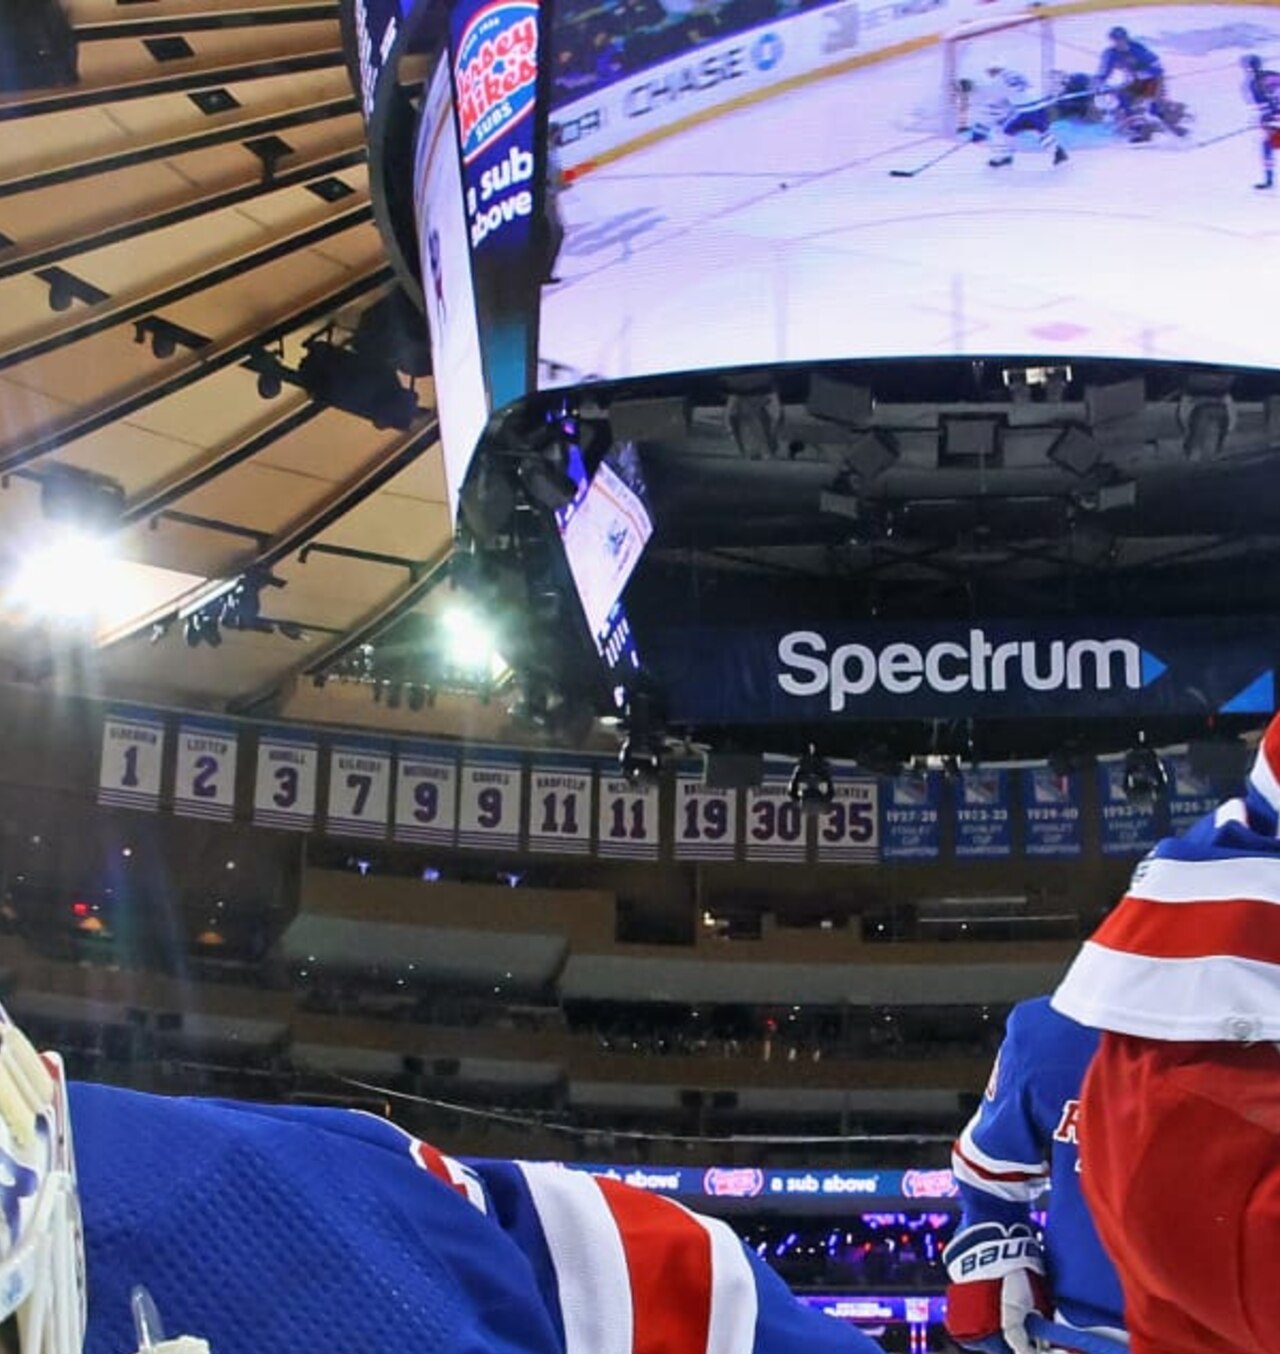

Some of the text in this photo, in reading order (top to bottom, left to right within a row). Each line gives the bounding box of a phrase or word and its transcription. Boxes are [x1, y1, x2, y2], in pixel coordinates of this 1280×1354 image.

[624, 46, 744, 118] CHASE
[475, 102, 513, 142] SUBS
[480, 146, 534, 200] sub
[776, 629, 1141, 712] Spectrum
[121, 745, 139, 787] 1
[192, 755, 219, 798] 2
[272, 766, 298, 808] 3
[346, 774, 373, 816] 7
[413, 781, 439, 823] 9
[477, 787, 503, 829] 9
[541, 792, 578, 834] 11
[609, 798, 647, 839] 11
[682, 798, 729, 840] 19
[751, 801, 802, 842] 30
[822, 802, 874, 843] 35
[770, 1180, 781, 1192] a
[786, 1174, 818, 1193] sub
[823, 1174, 878, 1193] above
